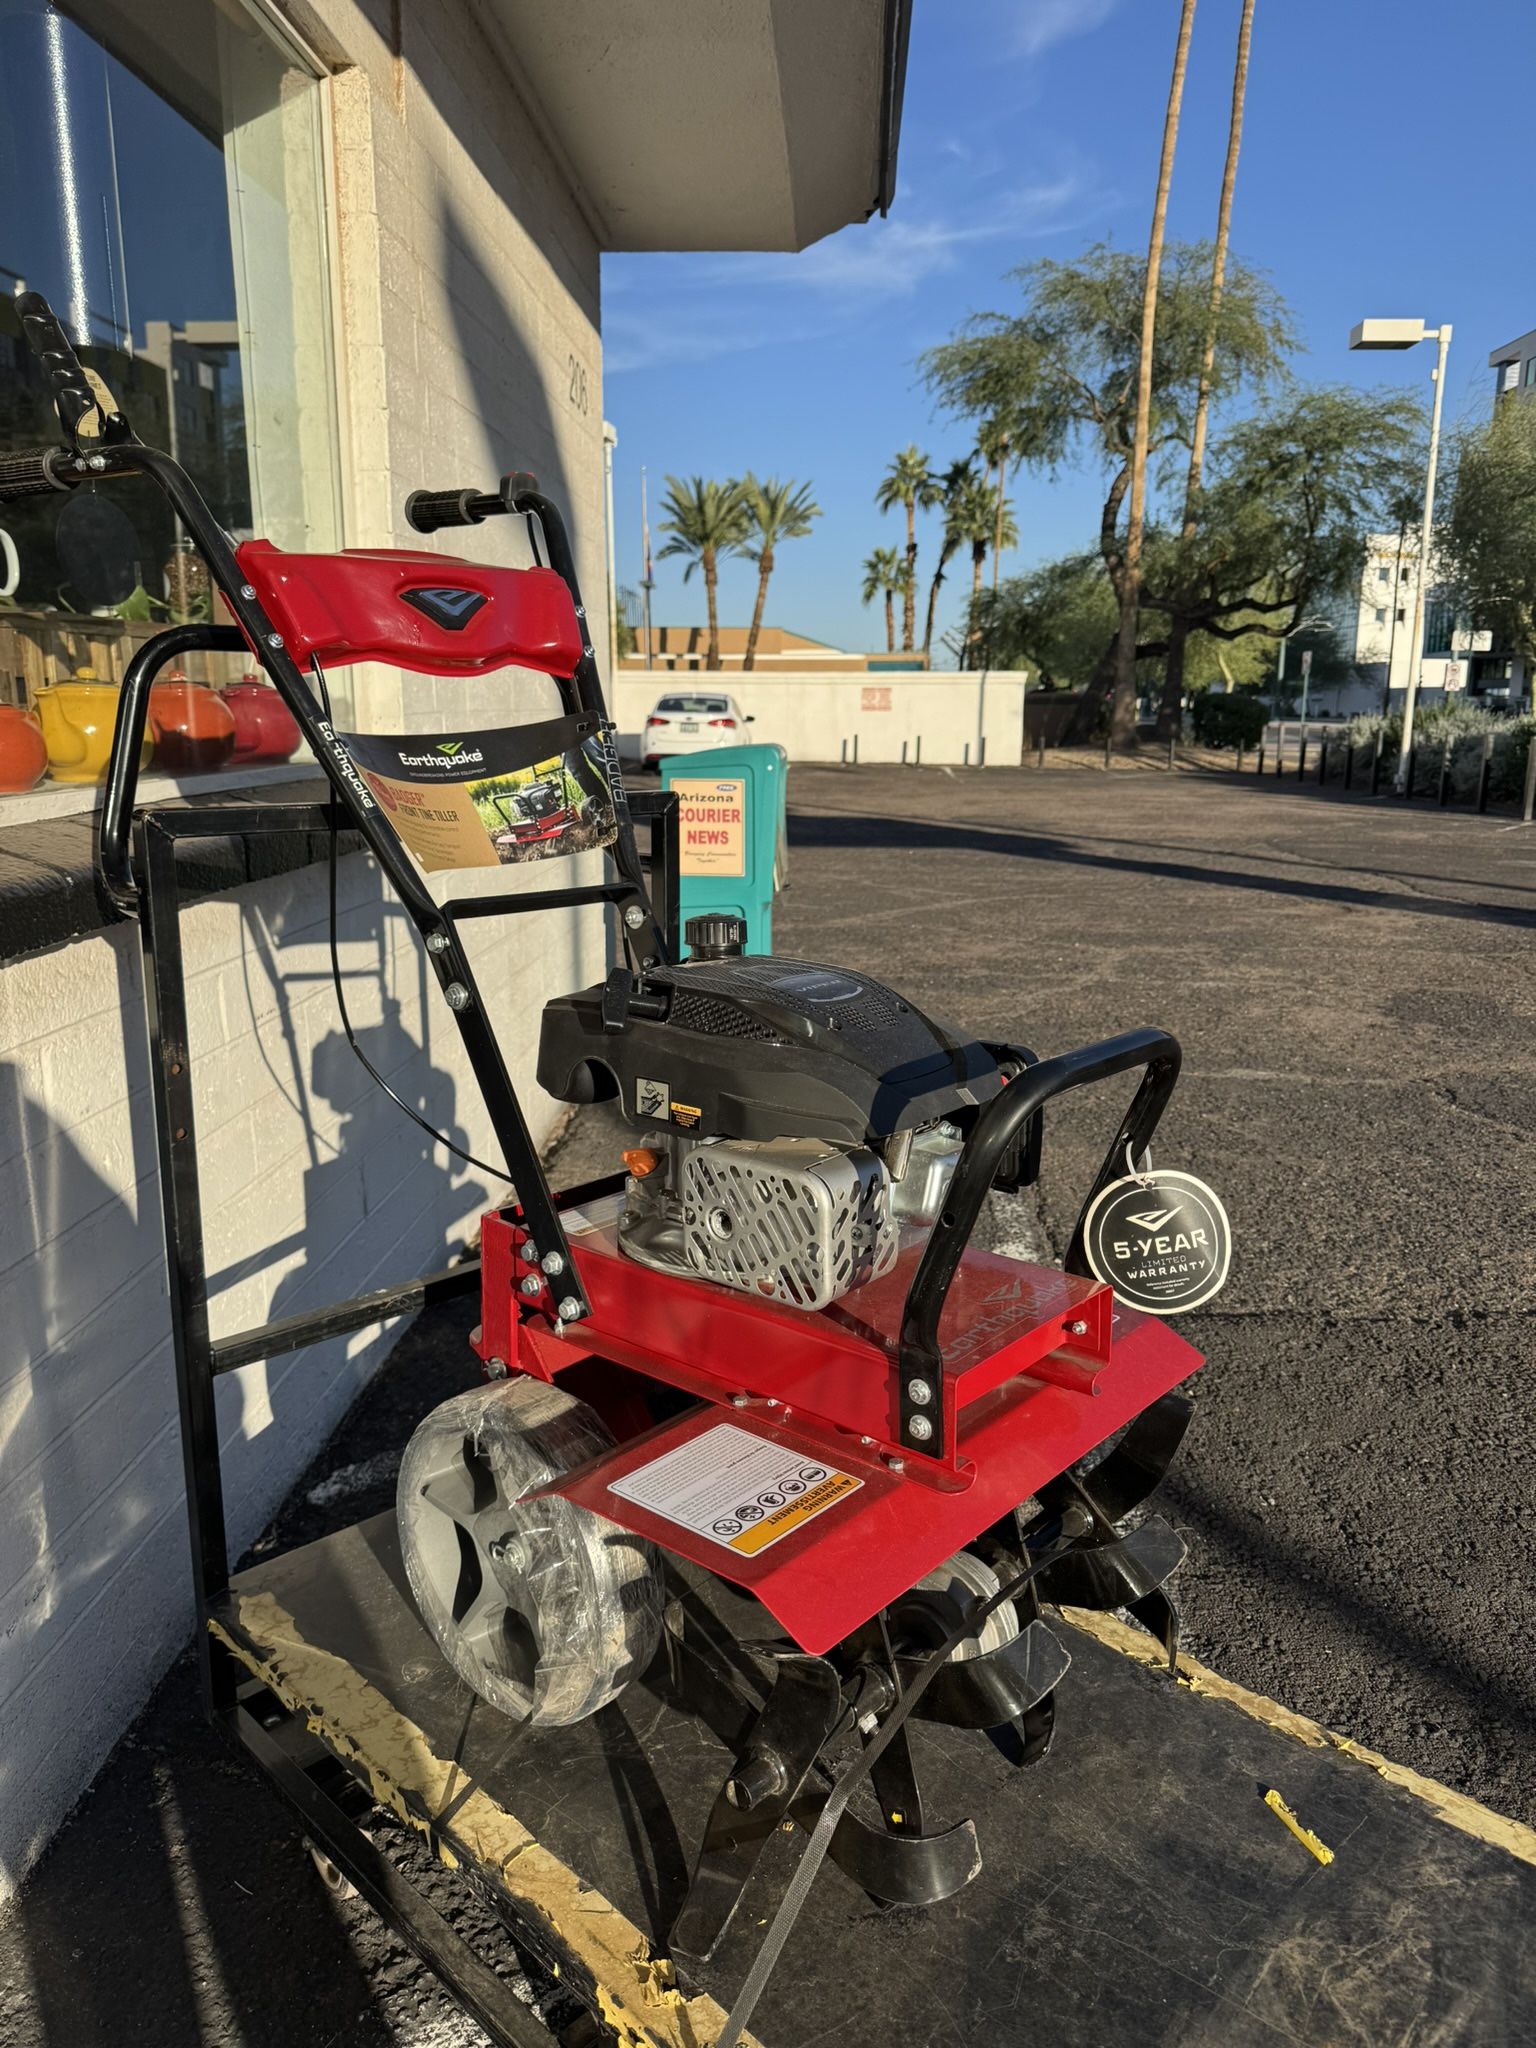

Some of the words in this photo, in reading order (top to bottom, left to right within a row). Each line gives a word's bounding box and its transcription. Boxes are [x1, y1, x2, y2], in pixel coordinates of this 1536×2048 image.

[318, 721, 376, 809] Earthquake
[398, 750, 484, 769] Earthquake
[680, 793, 734, 802] Arizona
[418, 808, 436, 821] TINE
[433, 810, 460, 823] TILLER
[687, 830, 729, 845] NEWS
[1113, 1228, 1209, 1259] 5-YEAR
[1127, 1260, 1206, 1279] WARRANTY
[1141, 1255, 1187, 1268] LIMITED
[767, 1480, 836, 1526] AVERTISSEMENT
[803, 1485, 843, 1512] WARNING
